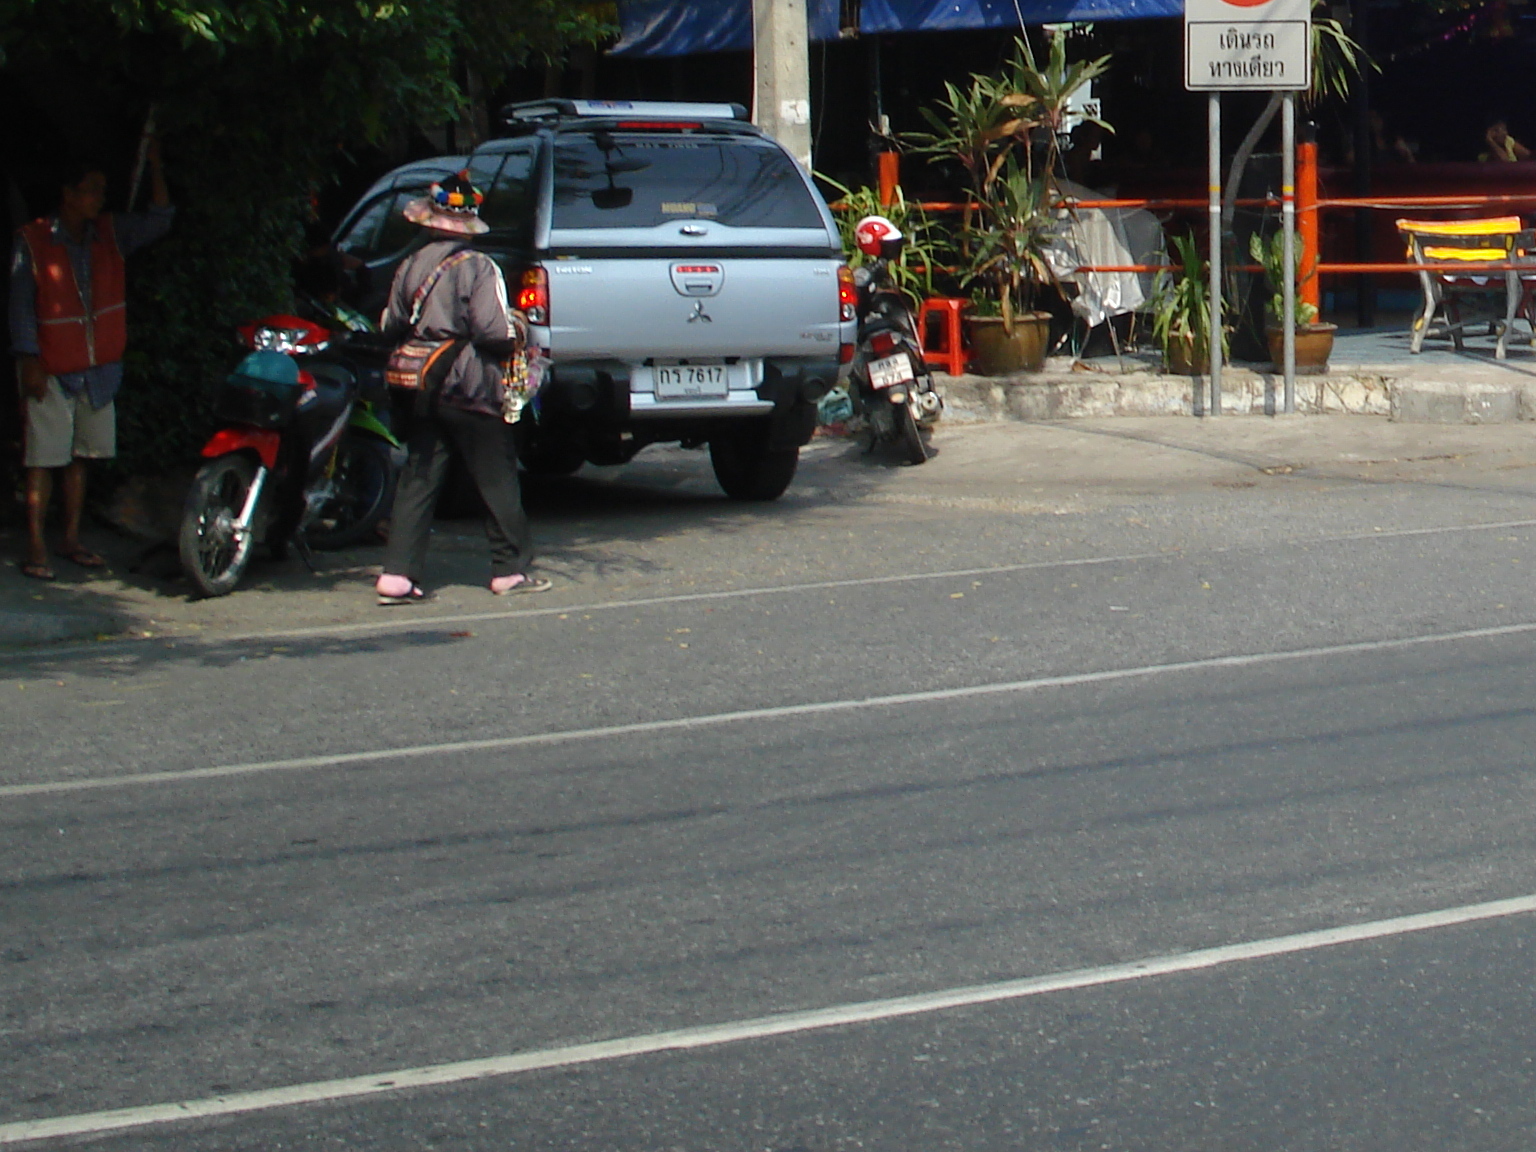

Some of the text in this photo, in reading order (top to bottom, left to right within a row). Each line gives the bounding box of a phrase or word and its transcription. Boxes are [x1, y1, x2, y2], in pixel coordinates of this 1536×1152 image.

[1219, 27, 1275, 50] เดินรถ
[1208, 54, 1285, 78] ทางเดียว
[686, 367, 722, 383] 7617
